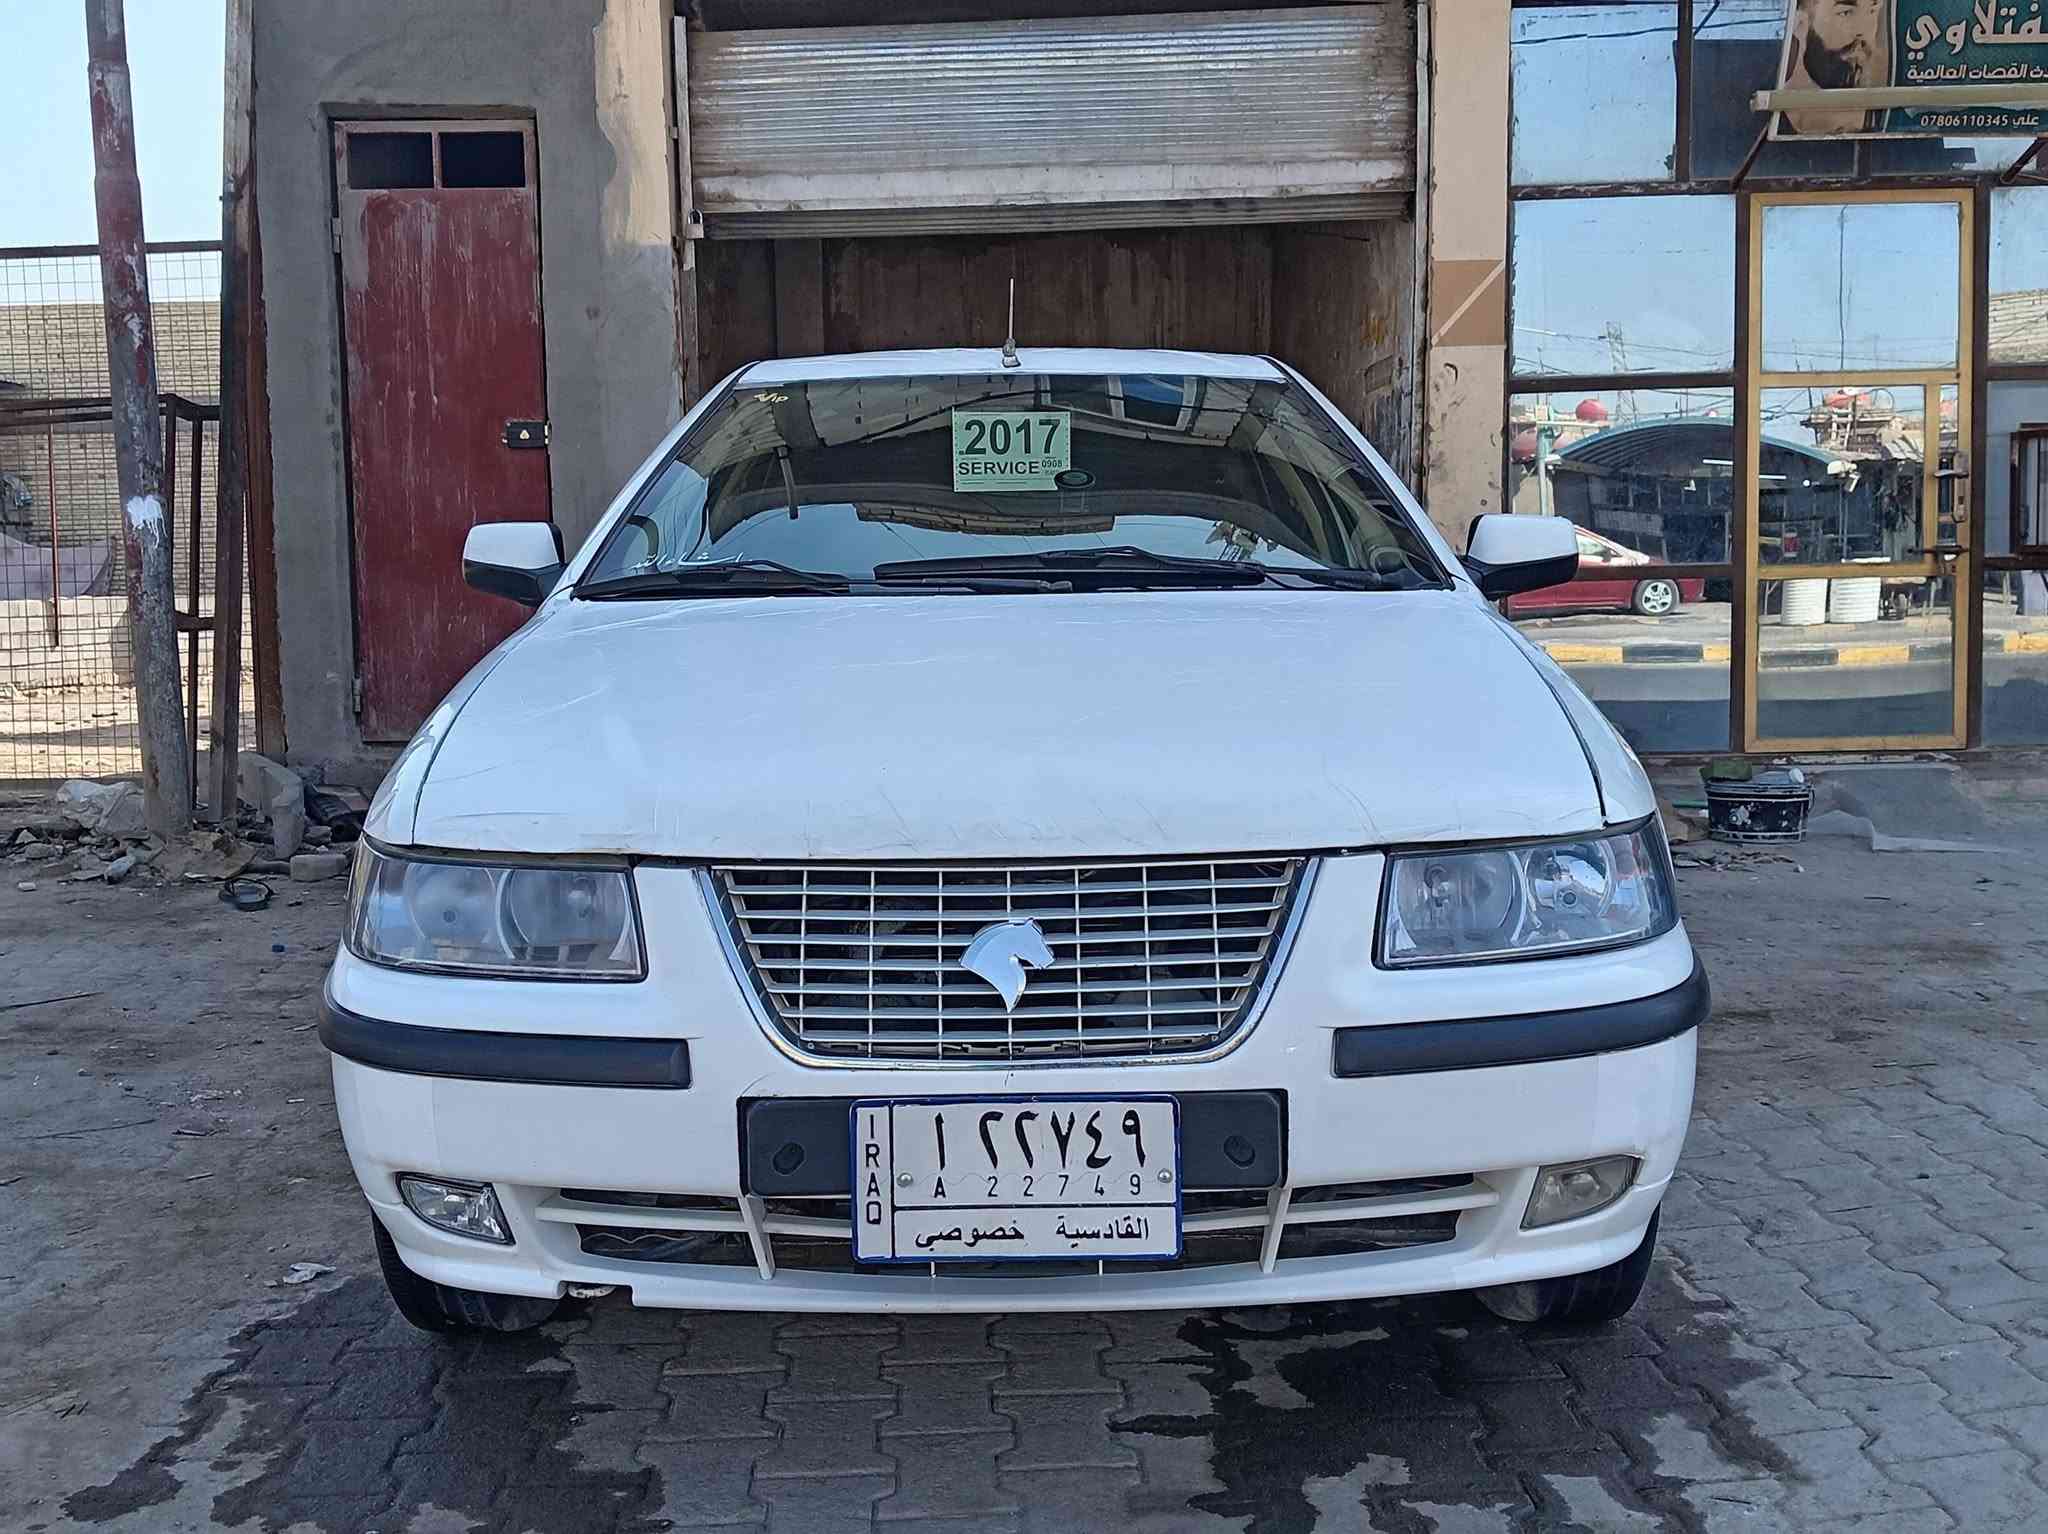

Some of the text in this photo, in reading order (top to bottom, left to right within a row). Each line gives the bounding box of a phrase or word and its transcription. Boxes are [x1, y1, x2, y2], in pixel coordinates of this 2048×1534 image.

[1907, 64, 1967, 82] العالمية
[1969, 63, 2028, 79] القصات
[1920, 114, 2039, 128] علي 07806110345
[964, 418, 1061, 455] 2017
[958, 461, 1039, 475] SERVICE
[865, 1114, 882, 1225] IRAQ
[915, 1214, 1150, 1251] القادسية خصوصي
